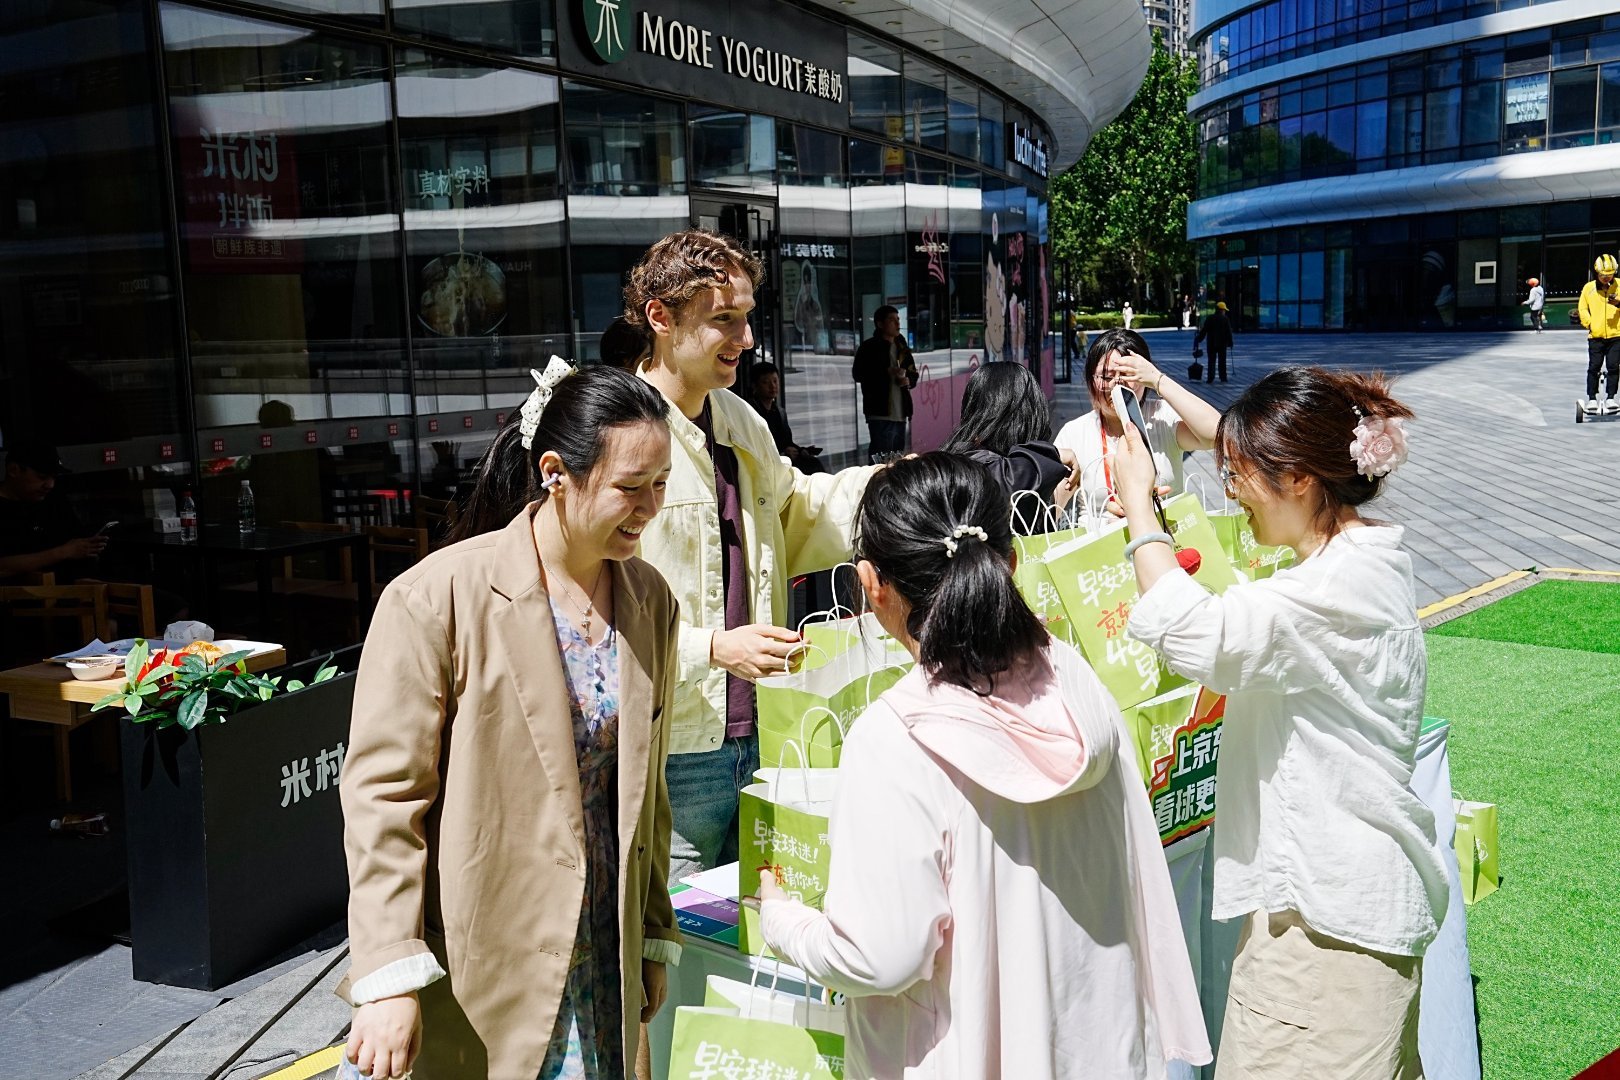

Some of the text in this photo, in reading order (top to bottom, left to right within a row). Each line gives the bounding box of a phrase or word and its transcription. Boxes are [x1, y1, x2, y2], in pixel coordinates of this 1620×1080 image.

[642, 11, 714, 69] MORE
[721, 36, 802, 92] YOGURT
[804, 62, 842, 103] 茉酸奶
[418, 164, 491, 199] 真材实料
[280, 742, 345, 808] 米村
[1155, 774, 1217, 833] 看球更
[753, 817, 818, 864] 早安球迷!
